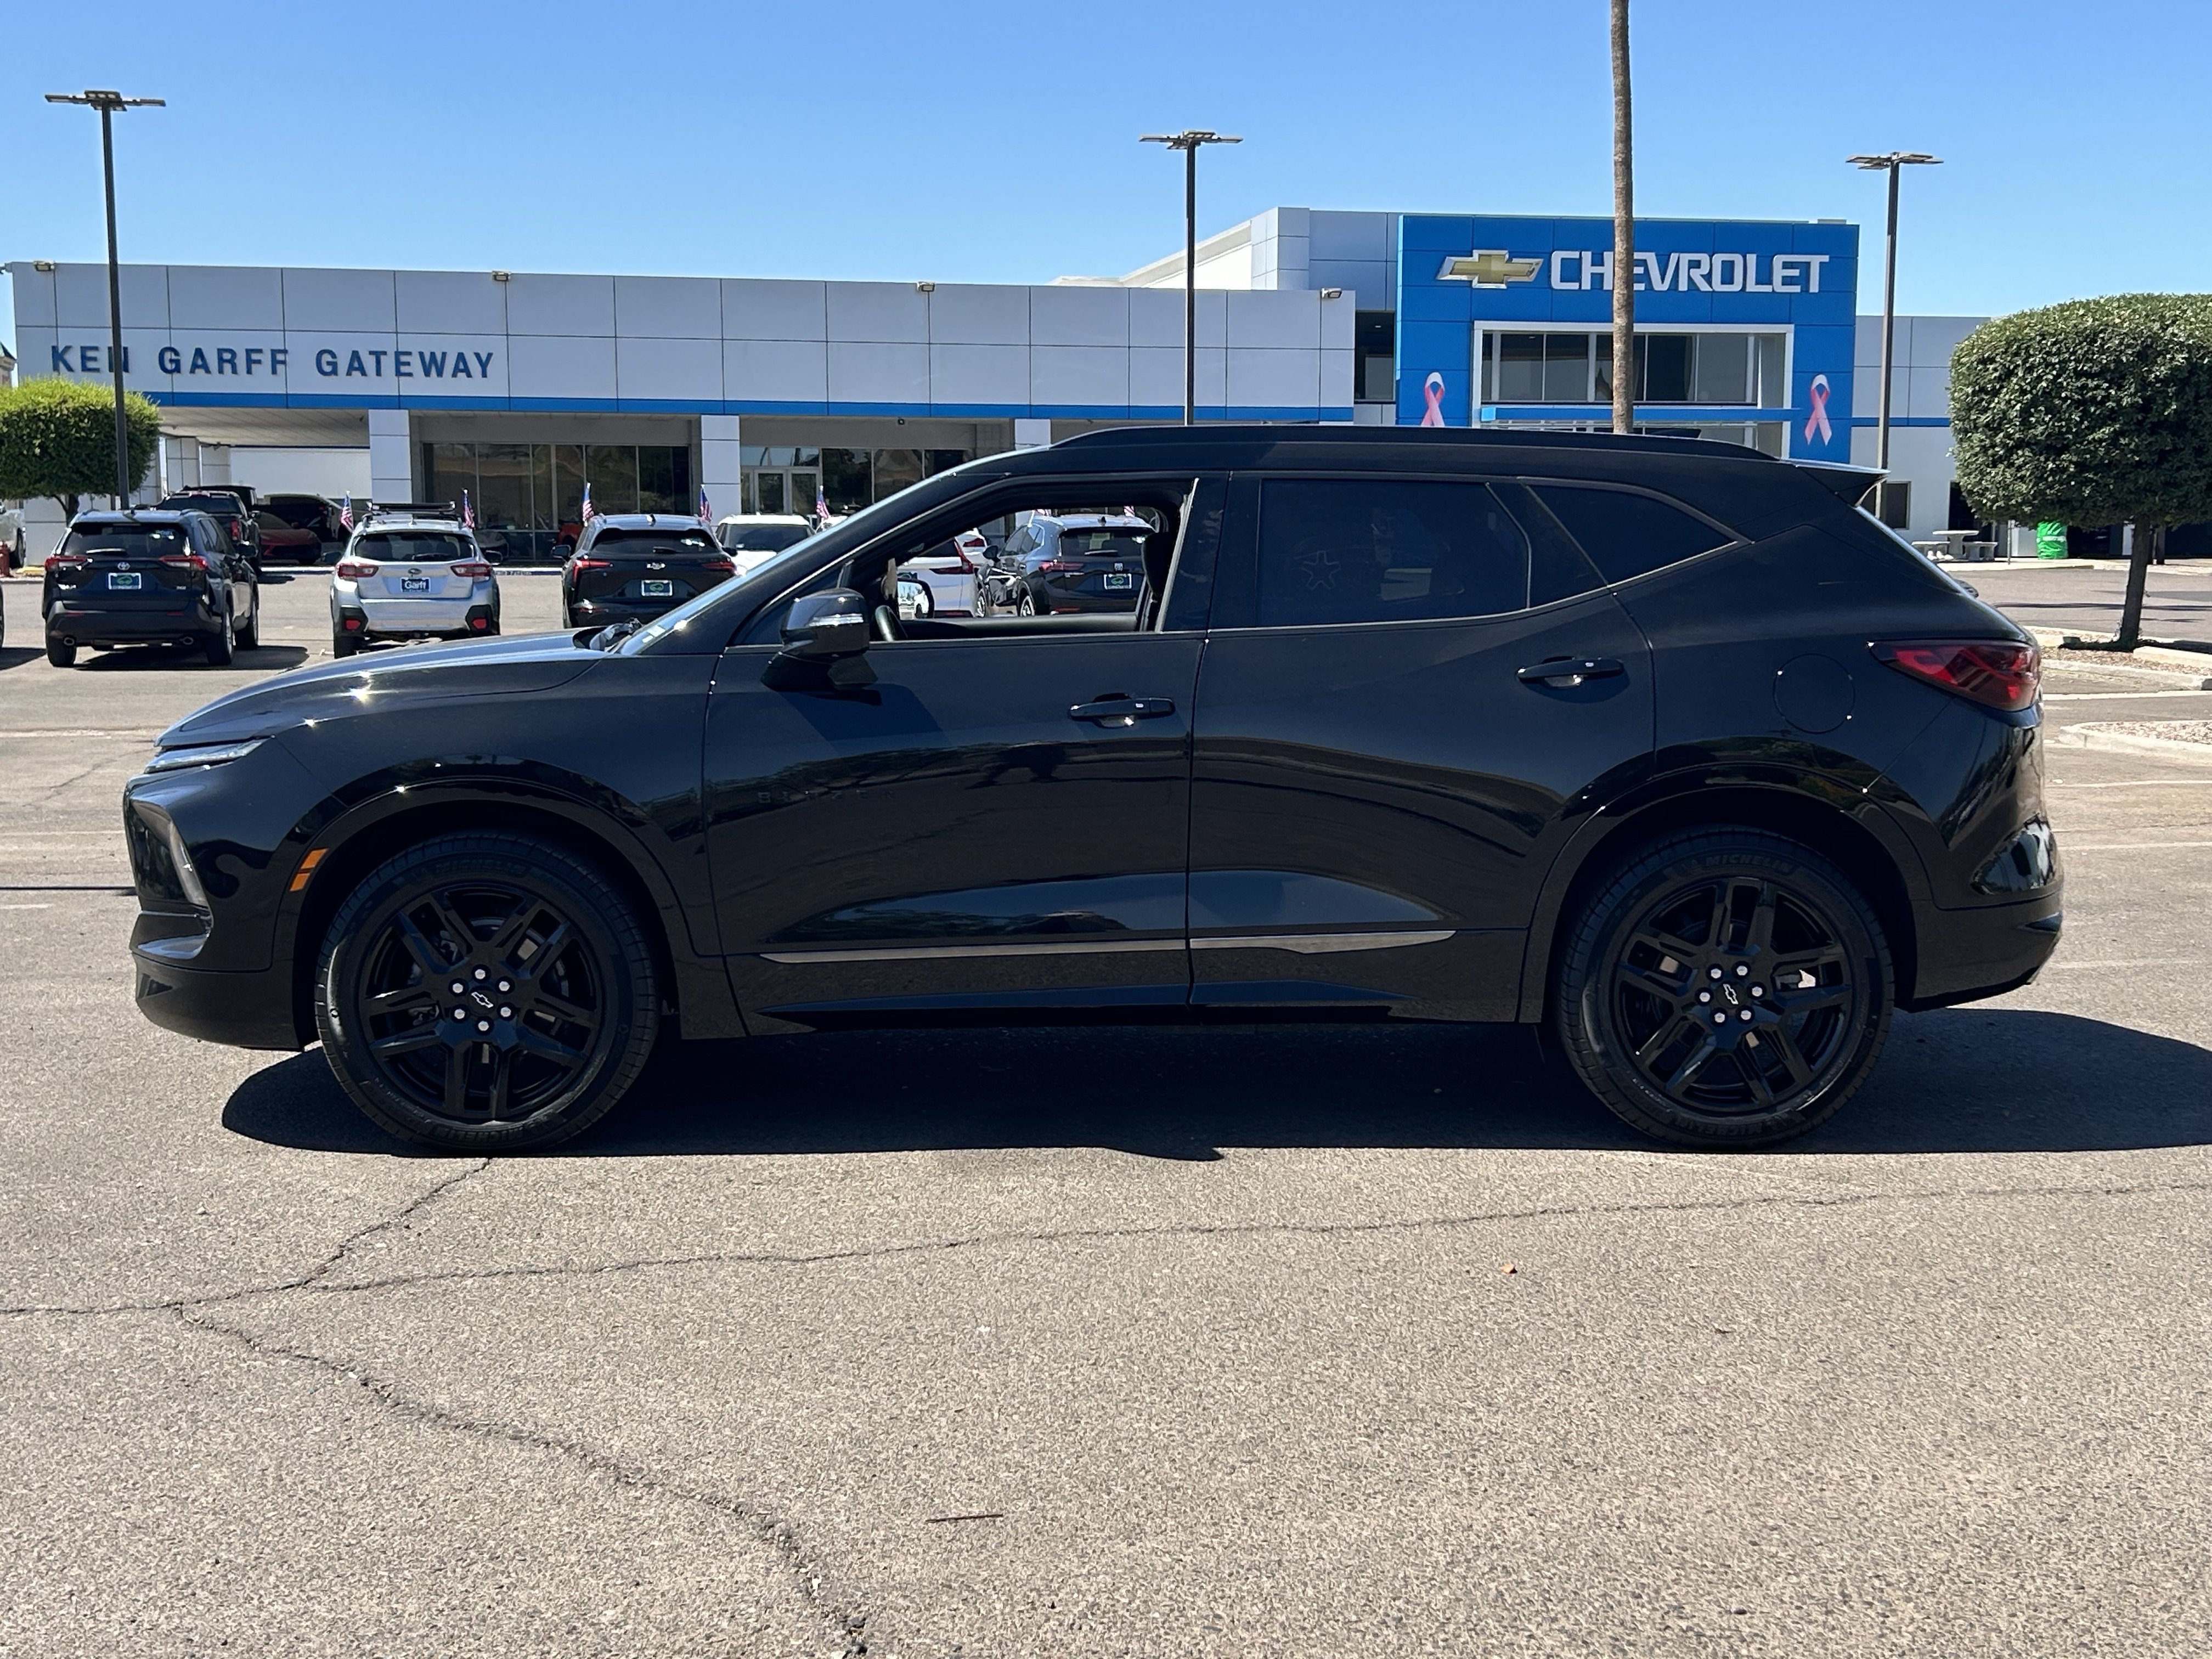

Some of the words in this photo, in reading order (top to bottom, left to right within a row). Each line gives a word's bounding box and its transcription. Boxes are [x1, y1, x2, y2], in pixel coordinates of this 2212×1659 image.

[159, 347, 289, 375] GARFF
[315, 349, 493, 378] GATEWAY
[1705, 854, 1795, 873] MICHELIN
